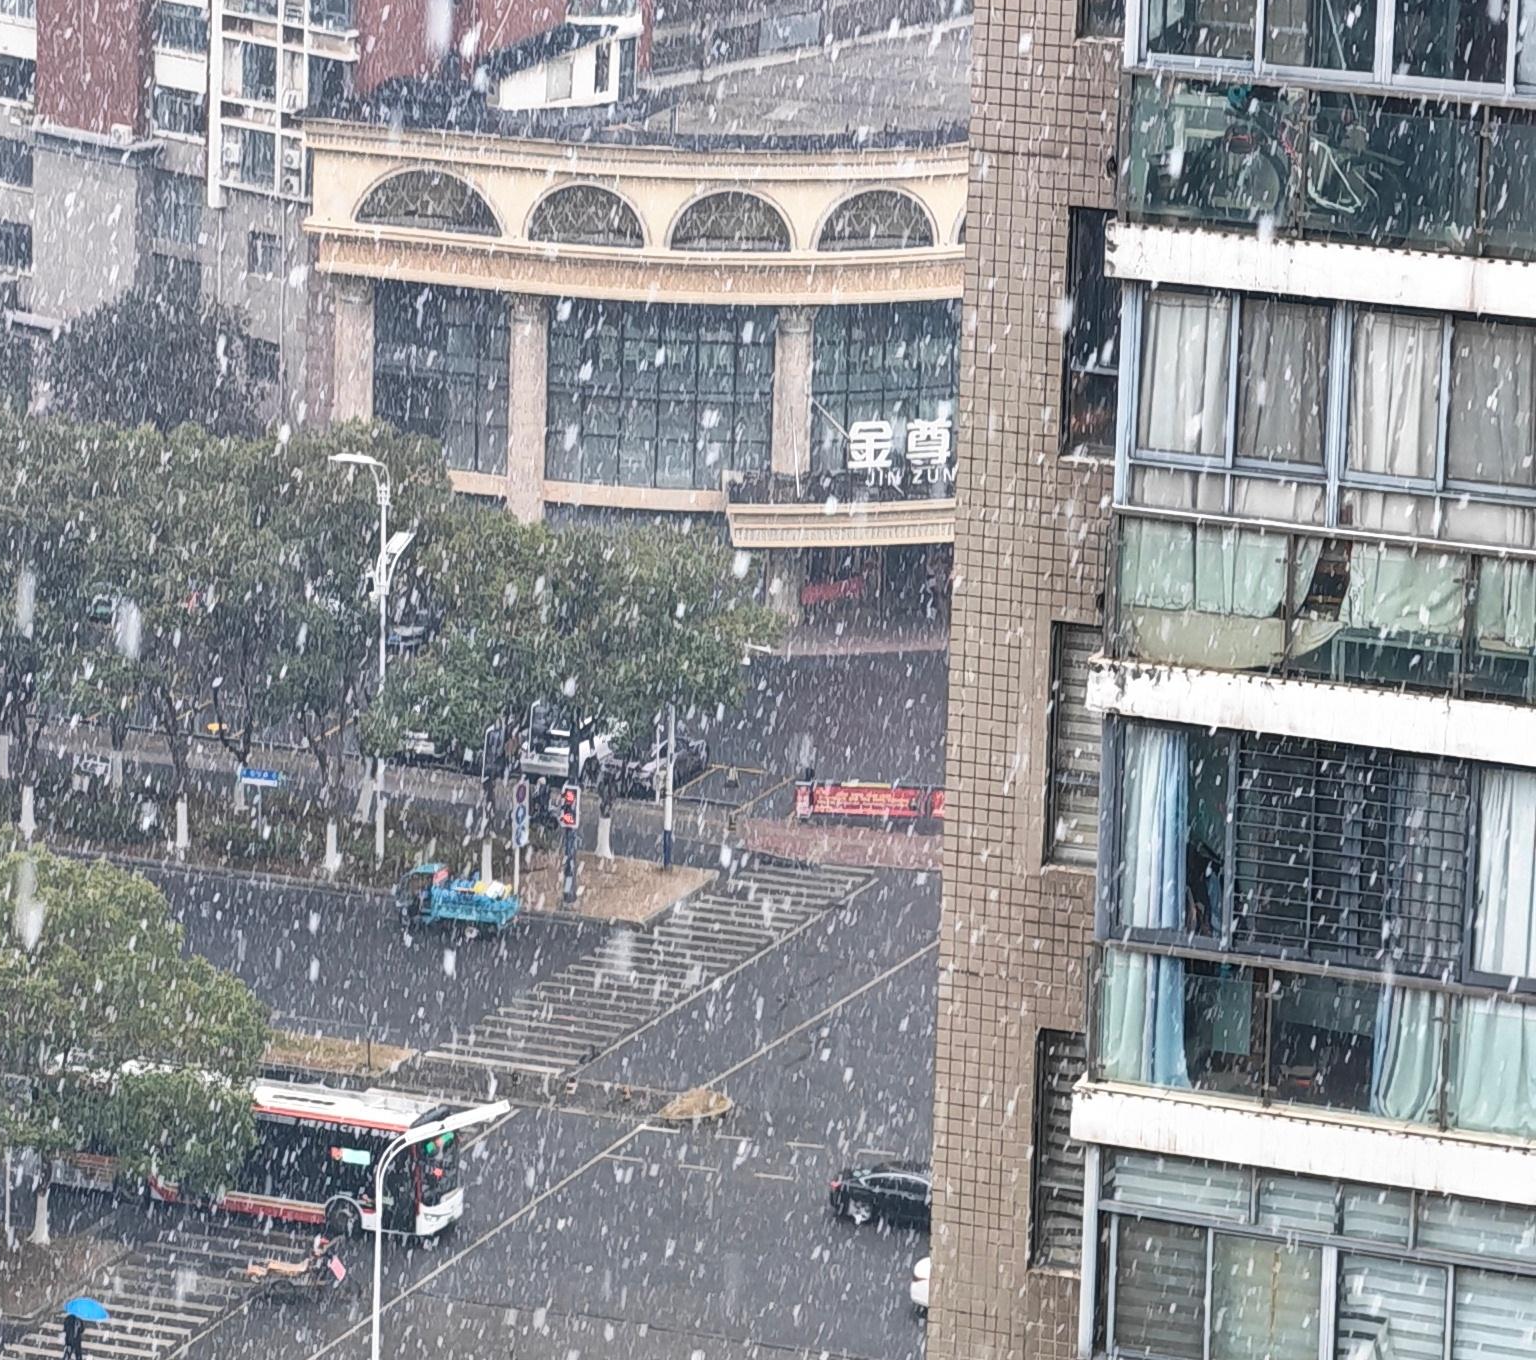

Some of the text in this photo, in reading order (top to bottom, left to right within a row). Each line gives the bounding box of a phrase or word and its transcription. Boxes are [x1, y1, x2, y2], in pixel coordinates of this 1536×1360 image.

[847, 419, 952, 469] 金尊
[865, 468, 958, 487] JIN ZUN
